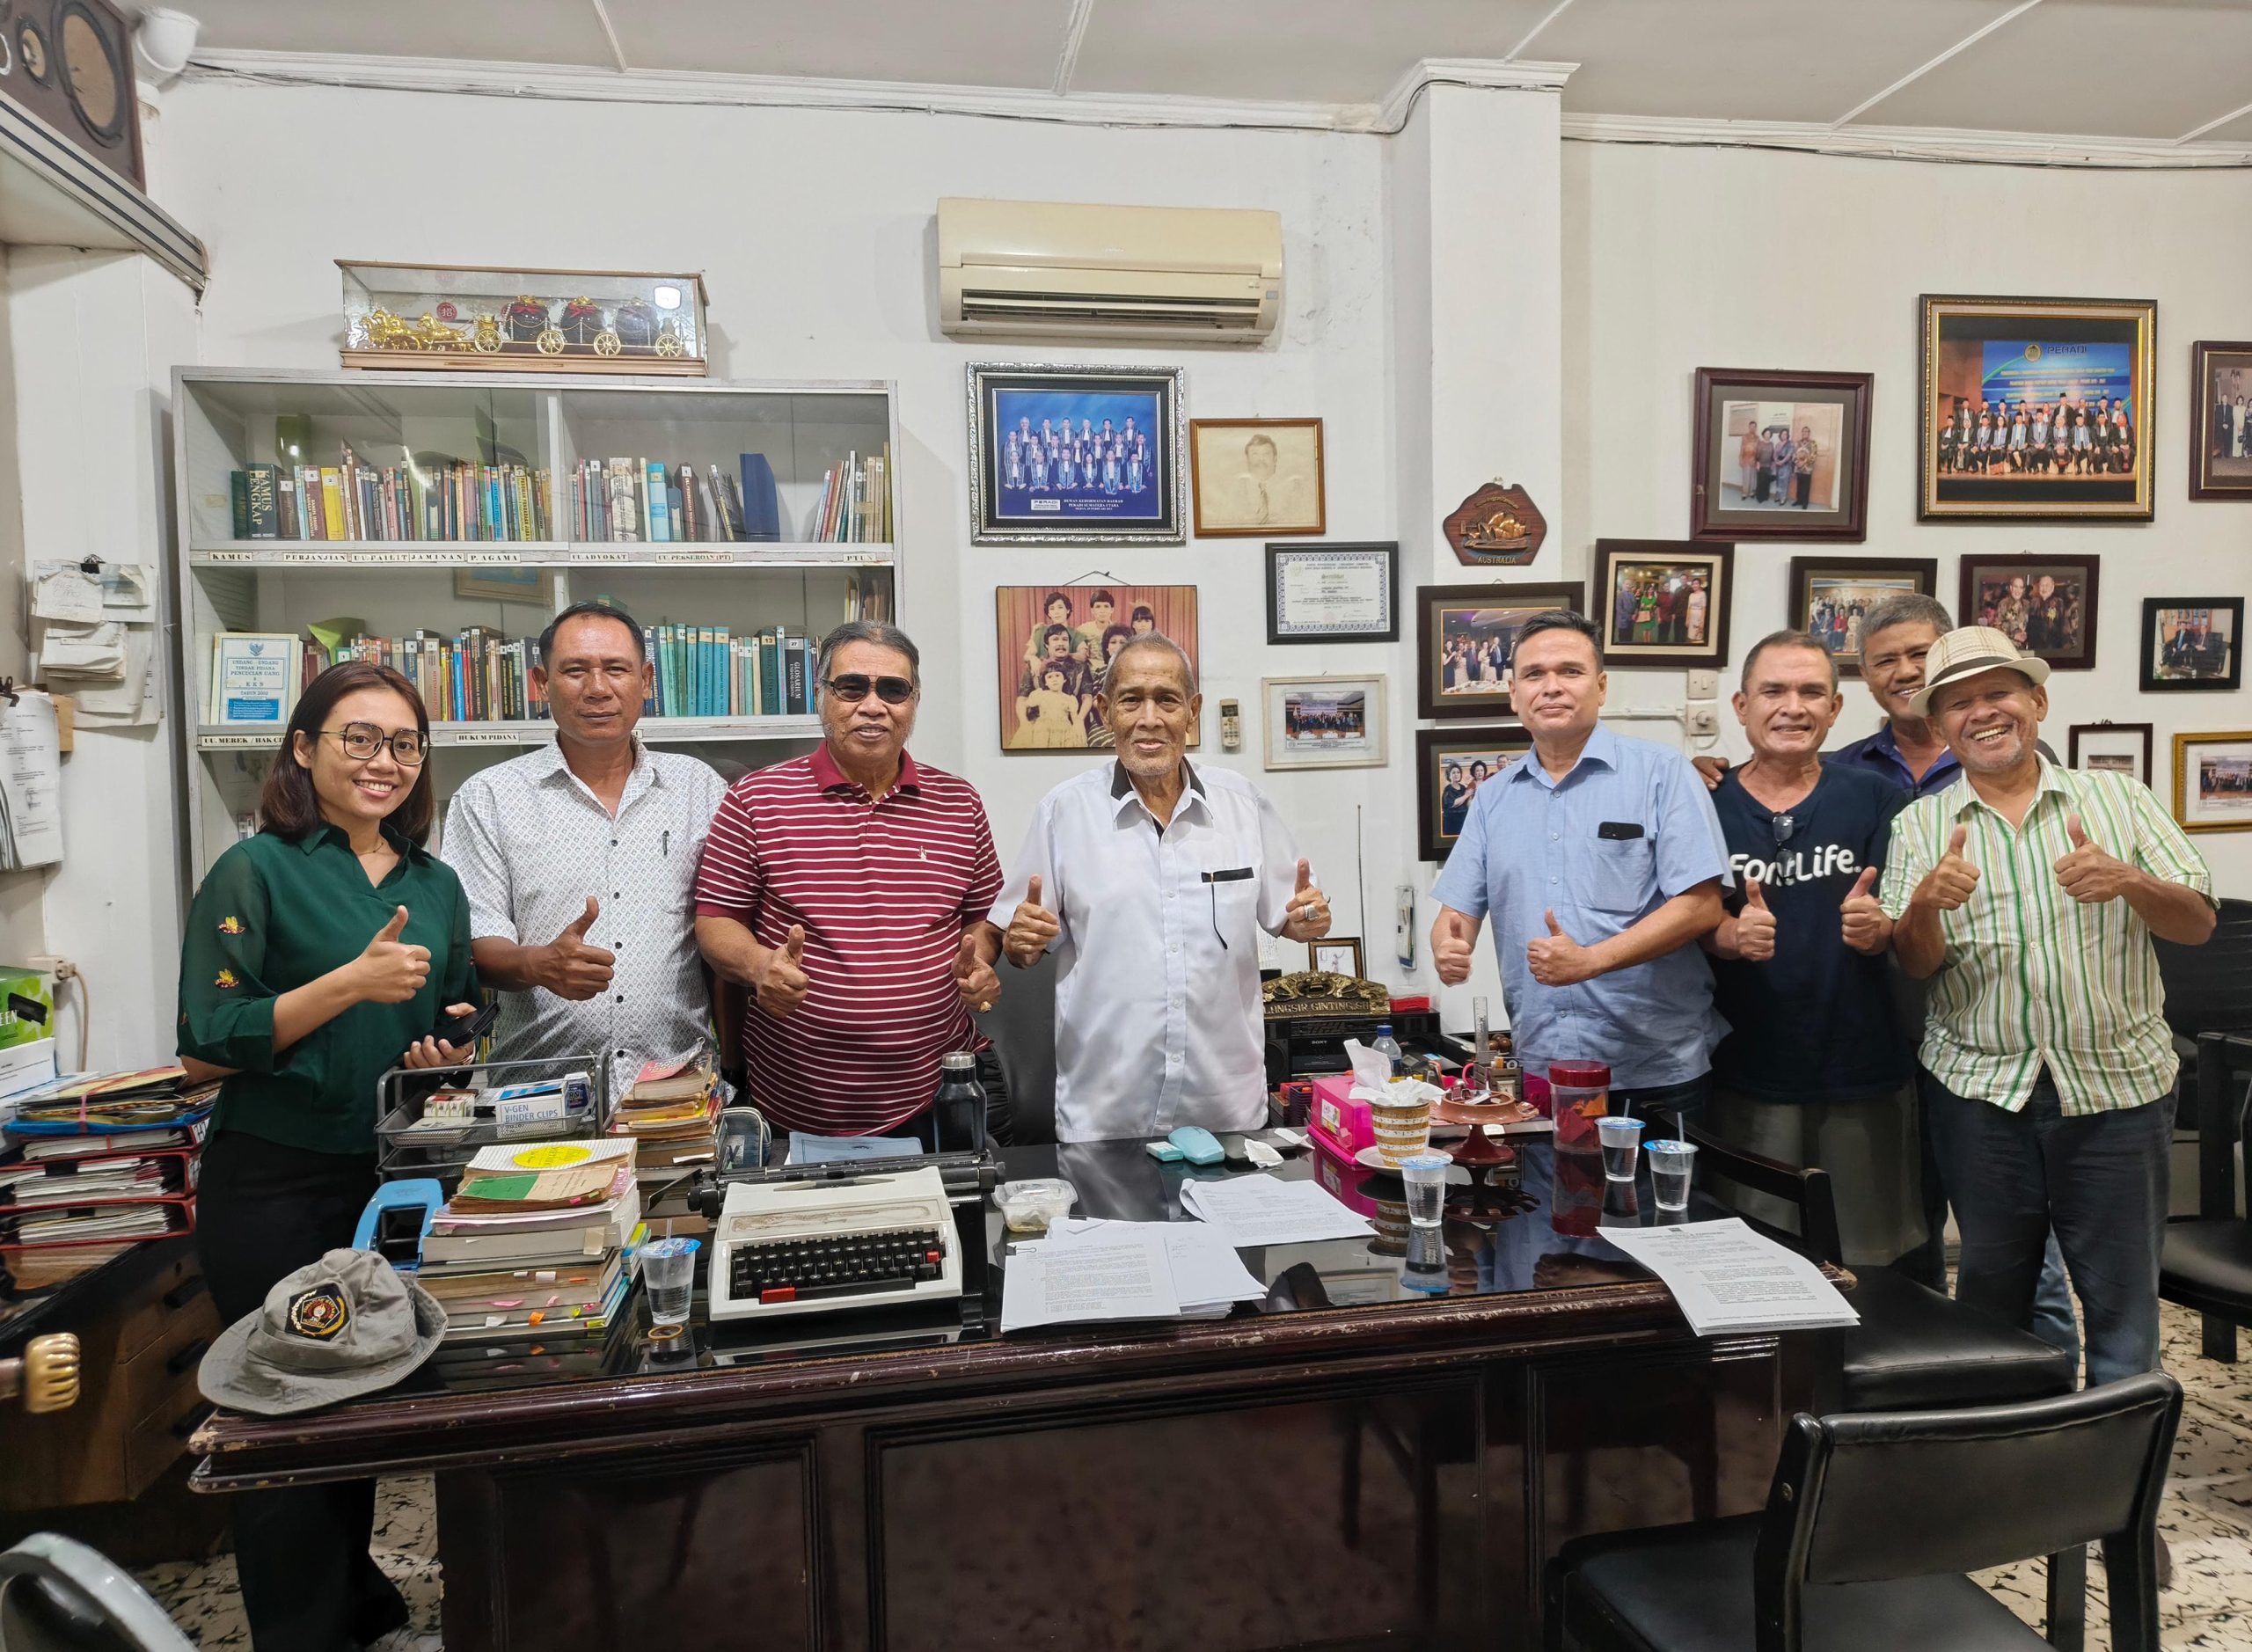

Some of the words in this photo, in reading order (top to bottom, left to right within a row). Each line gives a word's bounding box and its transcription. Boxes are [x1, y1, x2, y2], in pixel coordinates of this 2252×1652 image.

[2047, 345, 2087, 355] PERADI
[212, 552, 252, 560] KAMUS
[0, 1009, 18, 1025] EEN
[504, 1104, 529, 1114] V-GEN
[505, 1112, 534, 1122] BINDER
[537, 1109, 558, 1119] CLIPS
